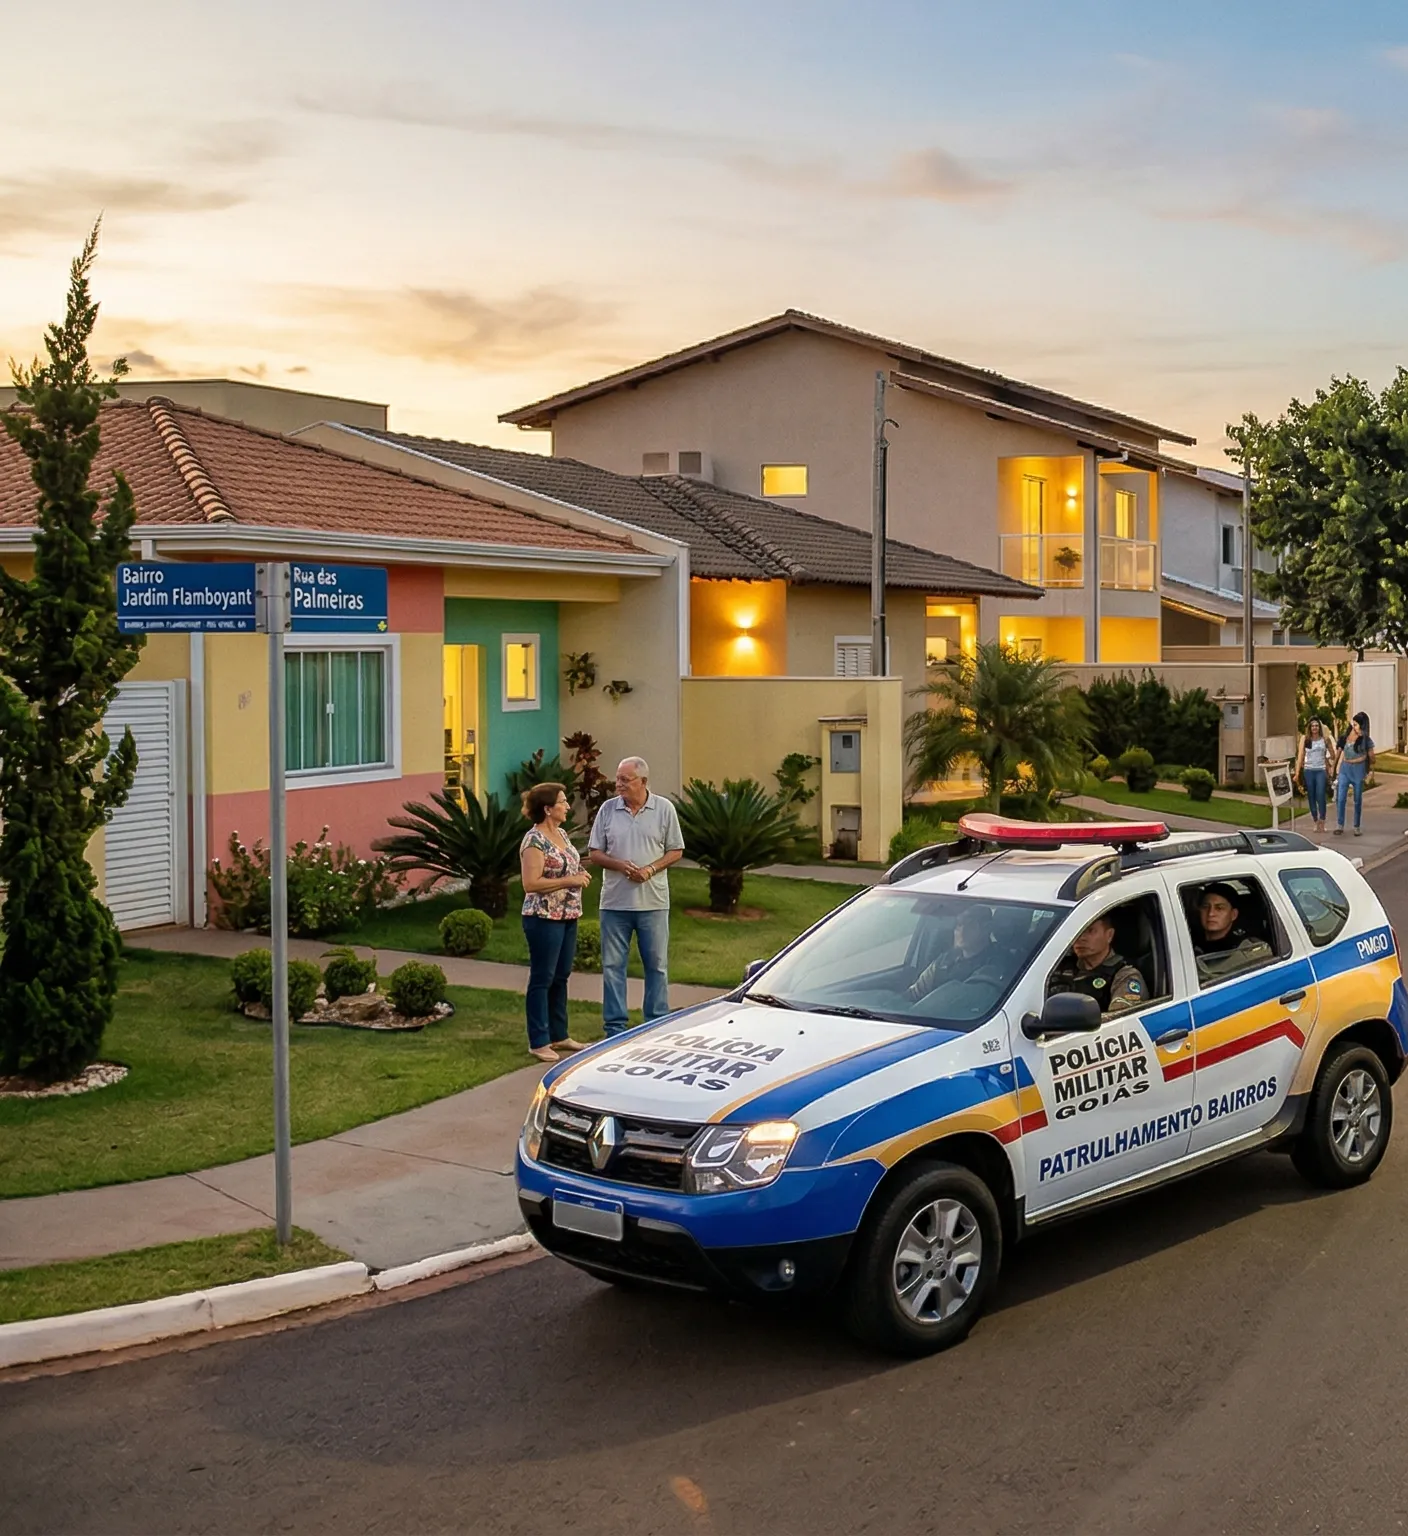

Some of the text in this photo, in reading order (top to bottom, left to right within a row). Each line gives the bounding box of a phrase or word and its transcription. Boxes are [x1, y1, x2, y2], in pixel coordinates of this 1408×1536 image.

[122, 567, 164, 584] Bairro
[293, 566, 315, 584] Rua
[122, 587, 253, 611] Jardim Flamboyant
[294, 587, 364, 610] Palmeiras
[654, 1033, 785, 1062] POLÍCIA
[1048, 1031, 1144, 1076] POLÍCIA
[596, 1063, 731, 1091] GOIÁS
[614, 1047, 757, 1079] MILITAR
[1053, 1055, 1149, 1104] MILITAR
[1055, 1080, 1150, 1120] GOIÁS
[1039, 1076, 1278, 1182] PATRULHAMENTO BAIRROS
